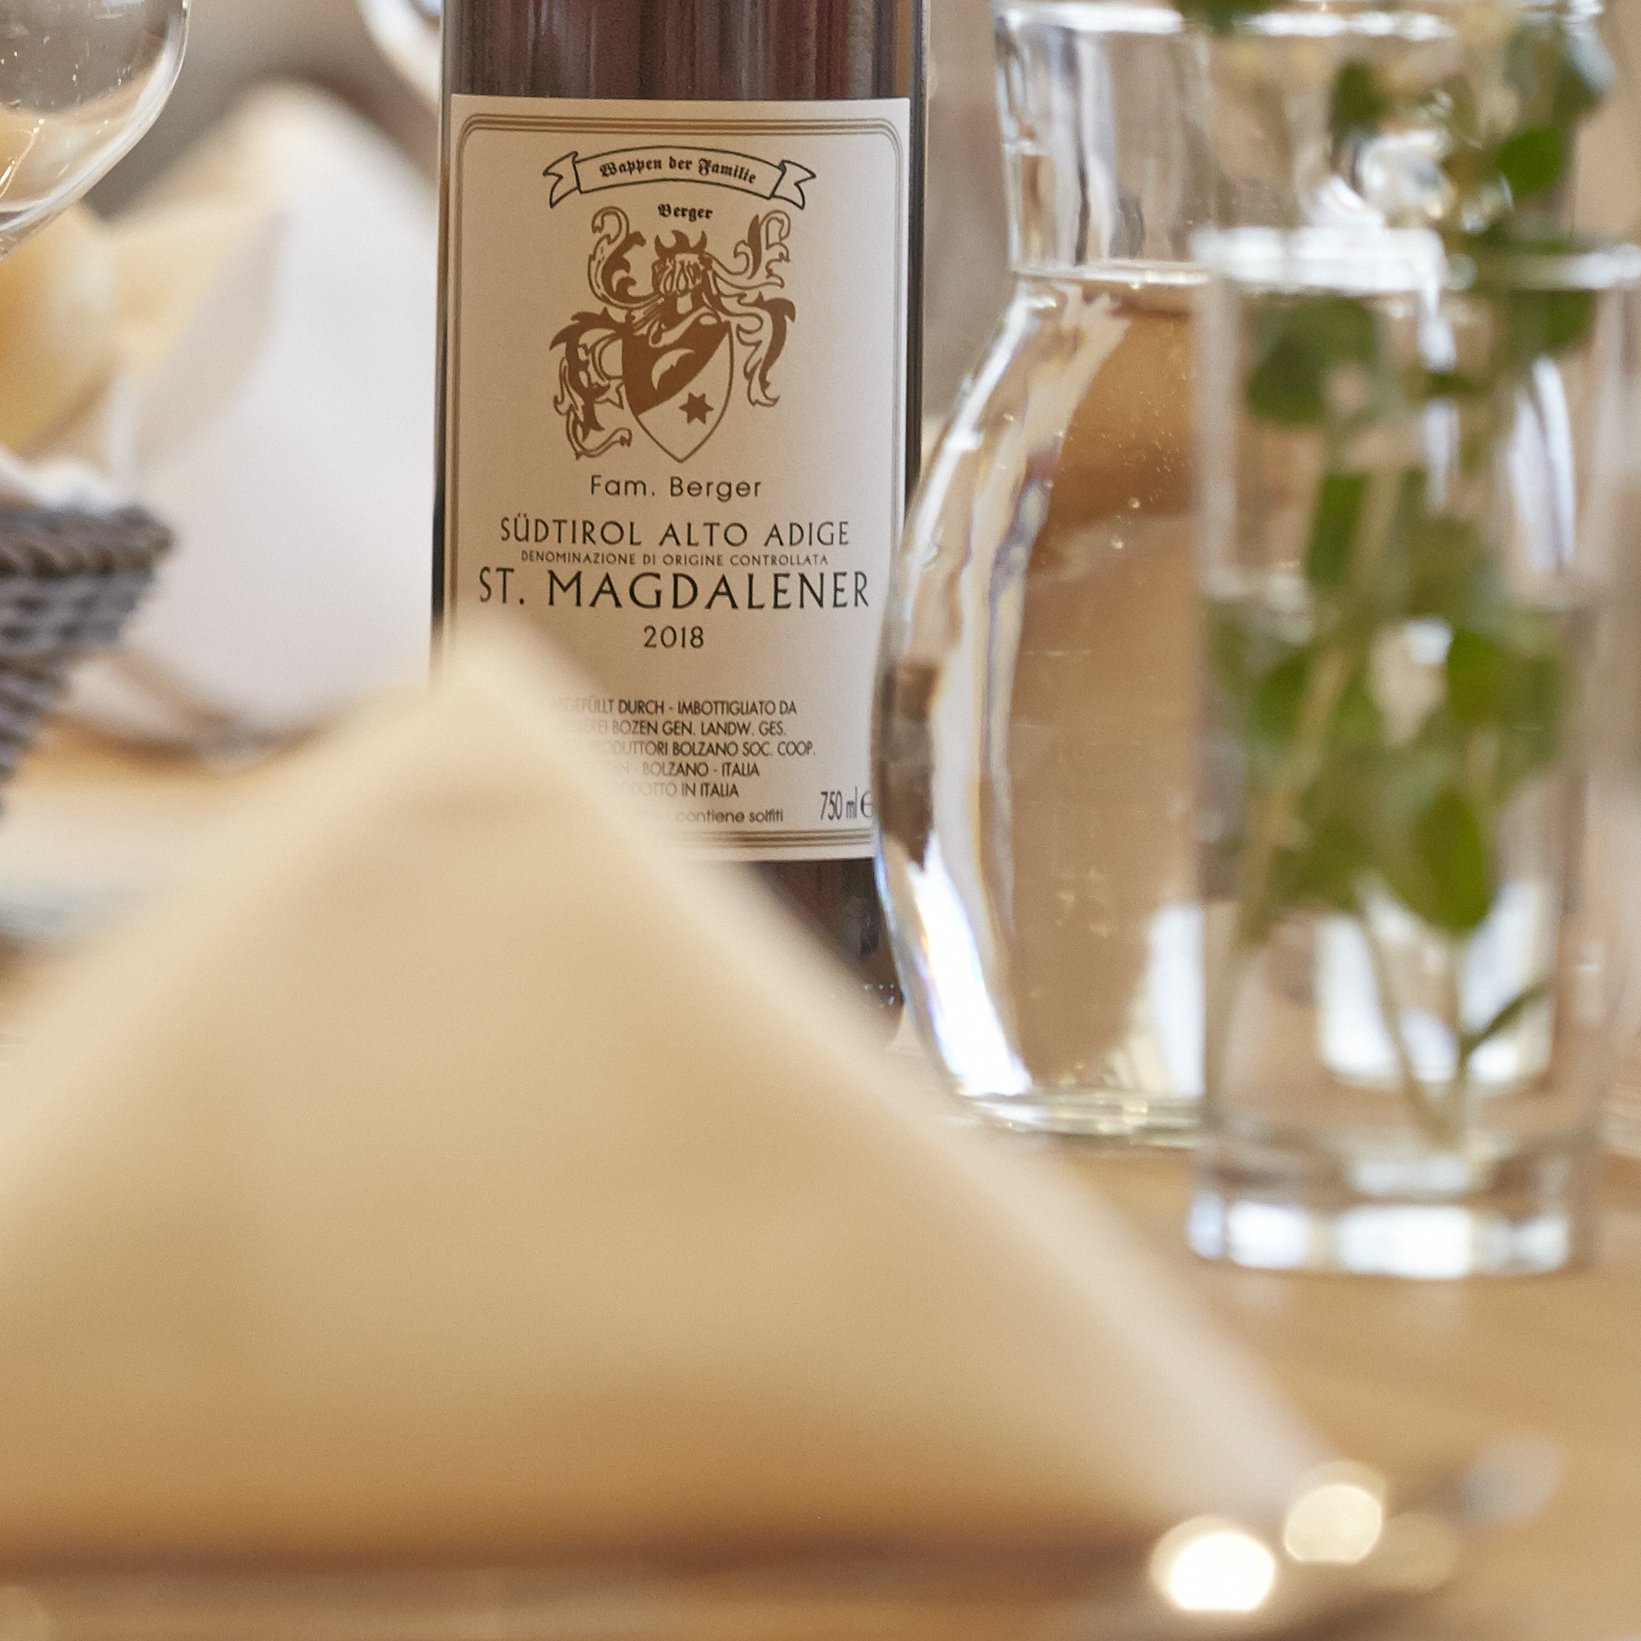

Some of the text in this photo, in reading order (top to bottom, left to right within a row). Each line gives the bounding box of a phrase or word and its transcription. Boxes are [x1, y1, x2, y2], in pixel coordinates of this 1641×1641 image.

[599, 156, 757, 184] Wappen der Familie
[657, 203, 713, 222] Berger
[590, 474, 762, 501] Fam. Berger
[500, 512, 850, 548] SÜDTIROL ALTO ADIGE
[521, 549, 828, 566] DENOMINAZIONE DI ORIGINE CONTROLLATA
[479, 565, 870, 610] ST. MAGDALENER
[643, 625, 705, 649] 2018
[618, 699, 664, 715] DURCH
[677, 700, 776, 716] IMBOTTIGLIATO
[779, 700, 797, 715] DA
[612, 719, 658, 735] BOZEN
[662, 720, 696, 736] GEN.
[701, 721, 755, 736] LANDW.
[759, 720, 787, 736] GES.
[672, 740, 739, 757] BOLZANO
[742, 740, 773, 756] SOC.
[777, 740, 816, 756] COOP.
[642, 761, 709, 777] BOLZANO
[721, 762, 760, 777] ITALIA
[681, 783, 696, 797] IN
[700, 783, 739, 798] ITALIA
[820, 790, 843, 821] 750
[845, 785, 858, 819] ml
[675, 809, 745, 823] contiene
